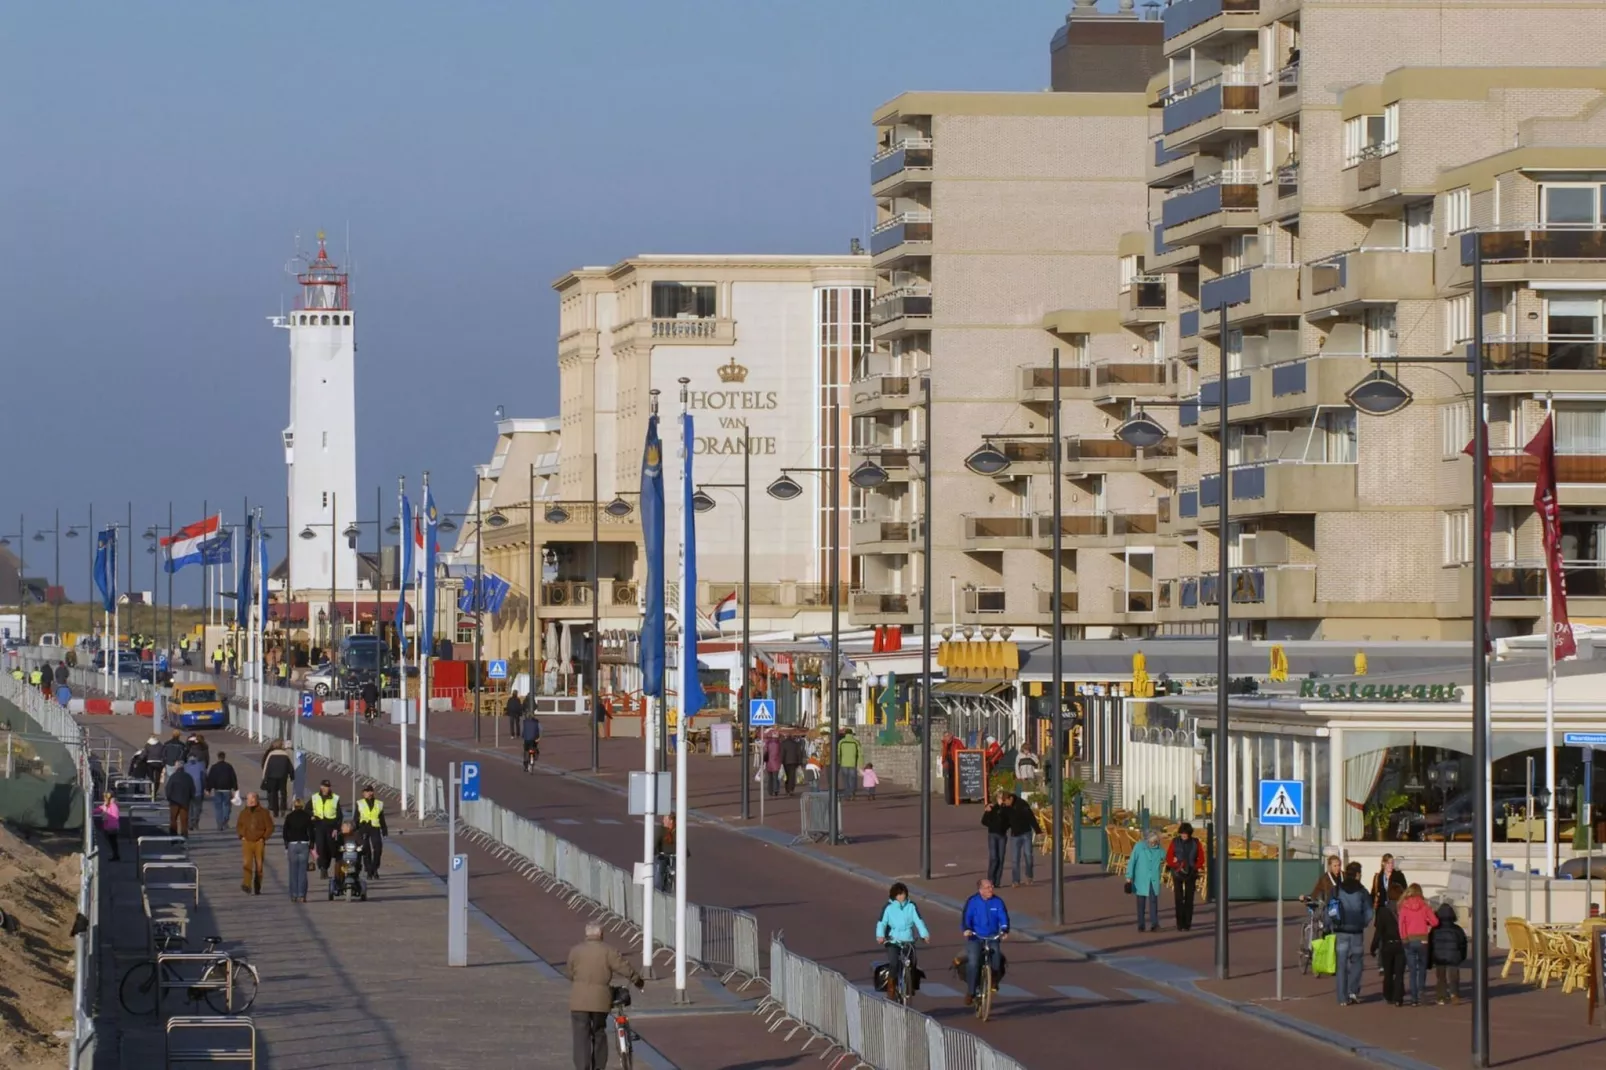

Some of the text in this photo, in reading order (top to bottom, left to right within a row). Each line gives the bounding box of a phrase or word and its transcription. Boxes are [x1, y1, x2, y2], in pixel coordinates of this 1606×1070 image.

[689, 391, 778, 410] HOTELS
[718, 416, 747, 429] VAN
[693, 436, 777, 455] ORANJE
[1300, 677, 1457, 698] Restaurant
[464, 764, 478, 785] P
[453, 857, 461, 869] P
